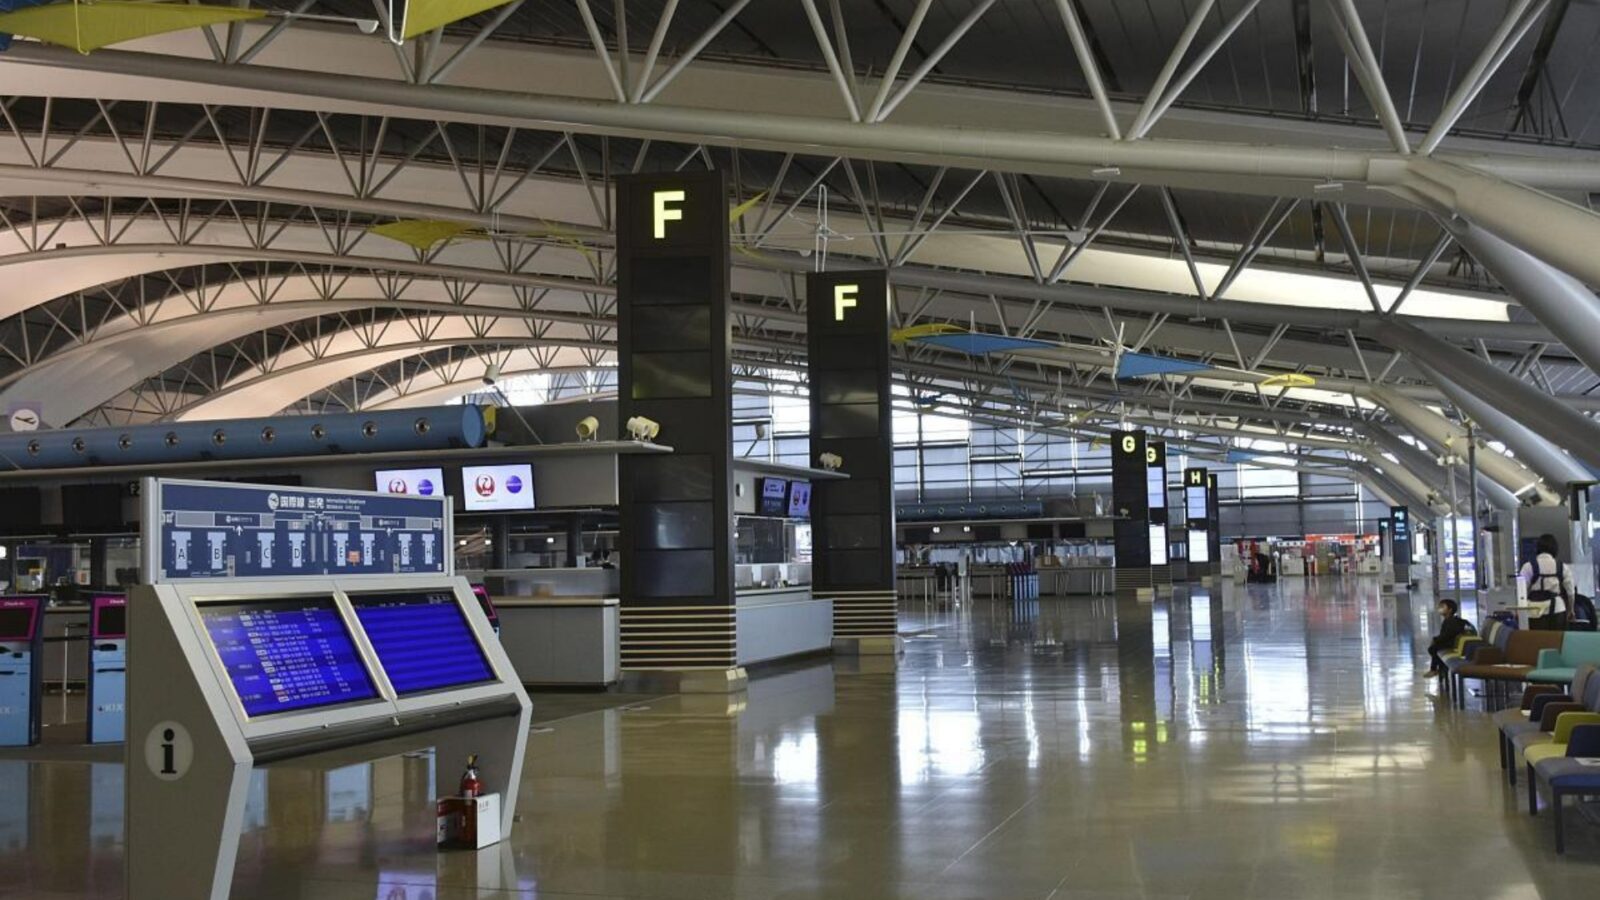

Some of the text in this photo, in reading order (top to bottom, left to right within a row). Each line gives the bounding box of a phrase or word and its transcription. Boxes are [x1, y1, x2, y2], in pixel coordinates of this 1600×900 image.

[653, 190, 685, 239] F
[834, 284, 859, 321] F
[1122, 435, 1135, 453] G
[1147, 447, 1156, 463] G
[1191, 471, 1201, 484] H
[178, 547, 186, 560] A
[214, 547, 221, 560] B
[263, 547, 270, 559] C
[294, 547, 301, 560] D
[338, 546, 344, 558] E
[365, 546, 371, 557] F
[402, 546, 409, 557] G
[425, 546, 432, 556] H
